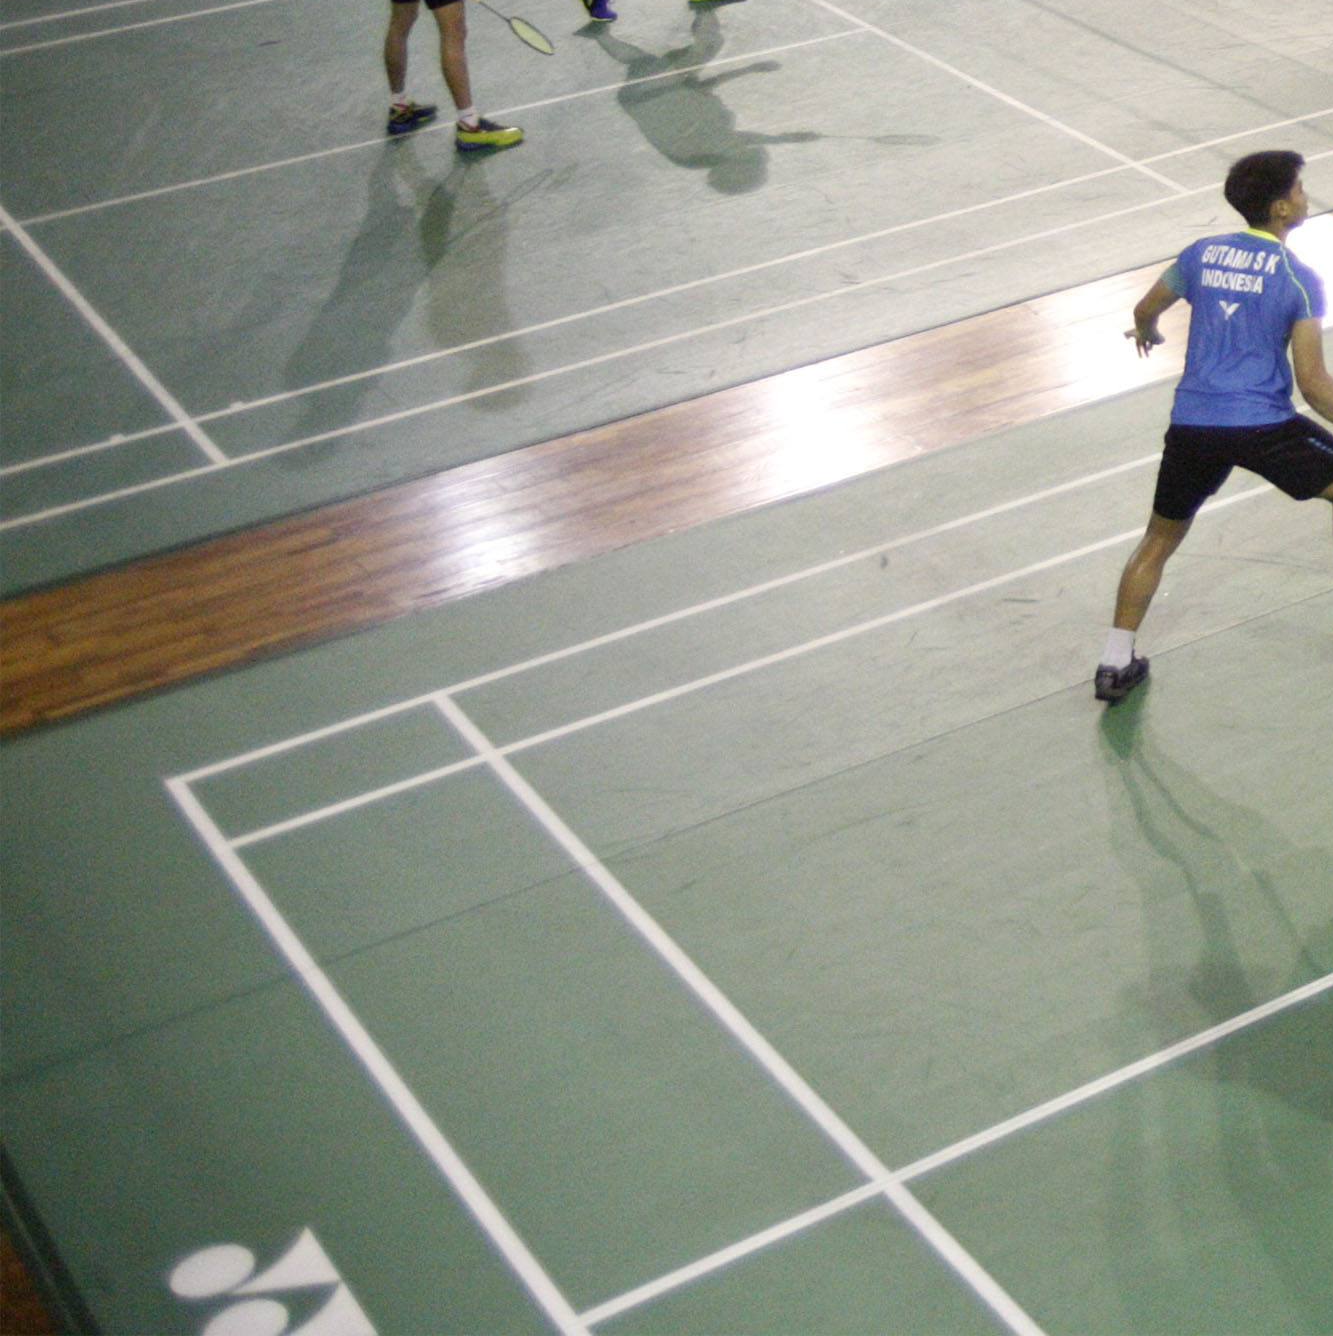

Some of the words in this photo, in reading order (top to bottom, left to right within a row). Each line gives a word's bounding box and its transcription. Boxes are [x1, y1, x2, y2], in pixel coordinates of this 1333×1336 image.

[1254, 251, 1266, 271] S
[1265, 254, 1281, 275] K
[1201, 269, 1264, 295] INDONESIA
